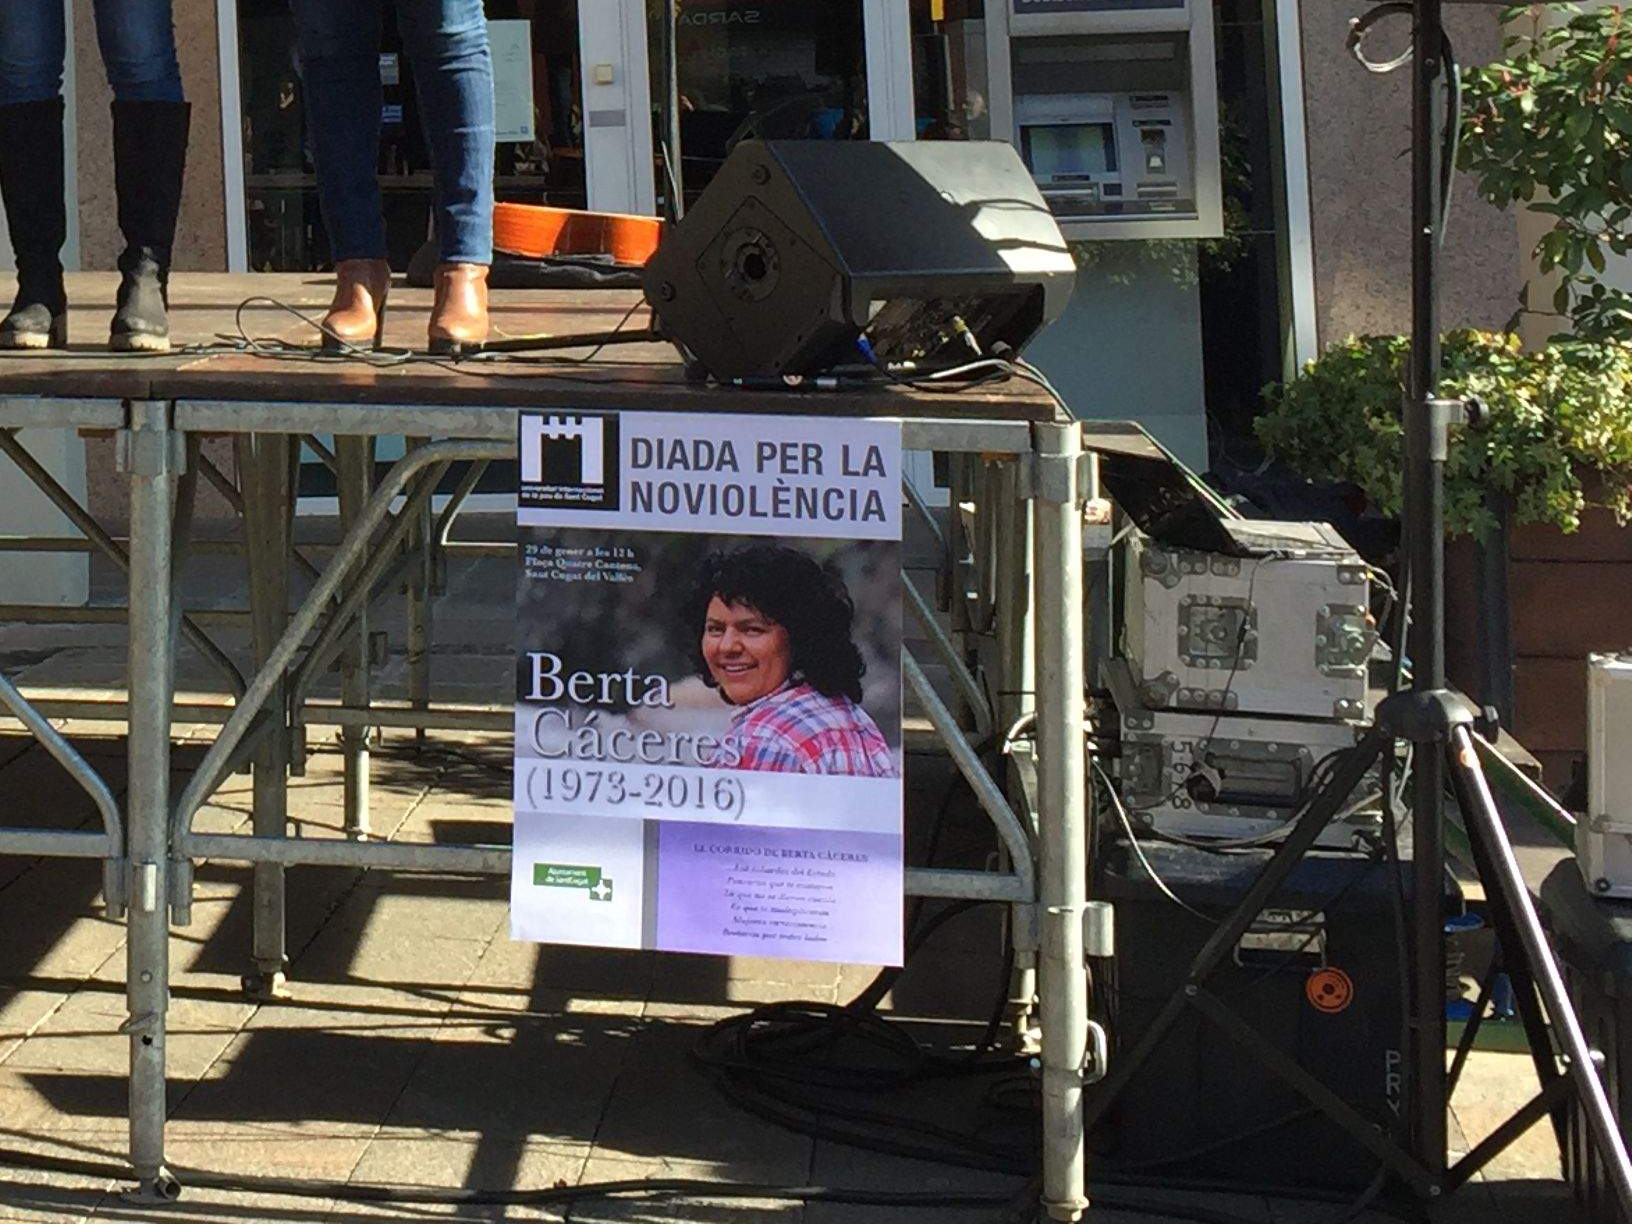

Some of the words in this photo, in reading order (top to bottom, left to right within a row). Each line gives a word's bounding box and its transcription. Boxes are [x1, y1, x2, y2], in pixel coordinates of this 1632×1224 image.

[629, 436, 739, 473] DIADA
[755, 440, 823, 475] PER
[841, 443, 887, 478] LA
[629, 478, 887, 523] NOVIOLÈNCIA
[524, 651, 674, 708] Berta
[527, 706, 742, 767] Cáceres
[525, 767, 747, 820] (1973-2016)
